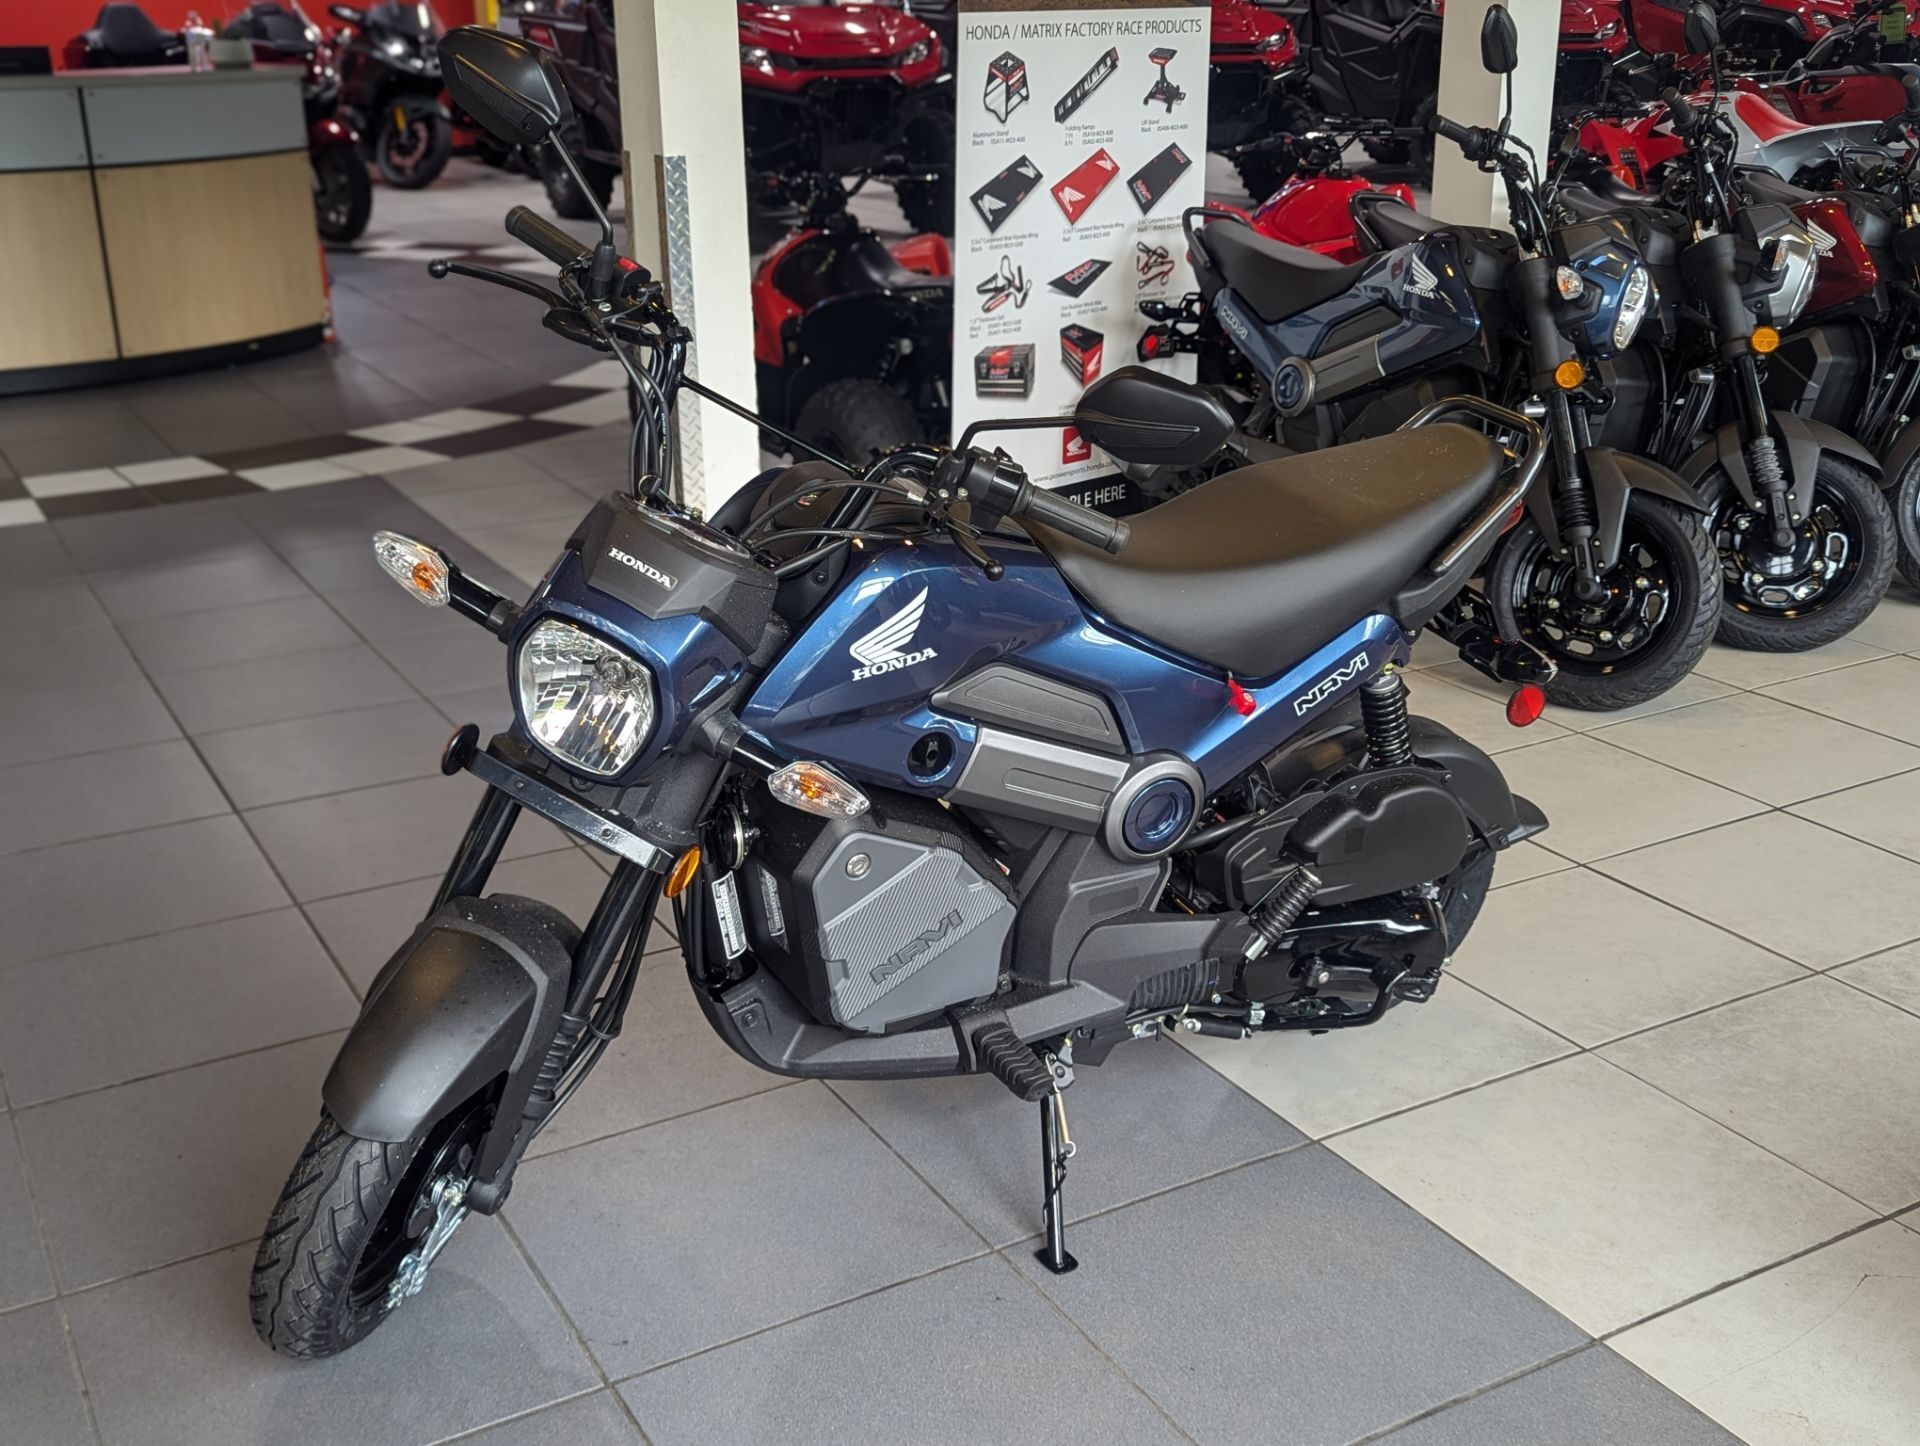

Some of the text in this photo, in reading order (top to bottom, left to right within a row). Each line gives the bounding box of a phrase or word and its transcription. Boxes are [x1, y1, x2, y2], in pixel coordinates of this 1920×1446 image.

[966, 19, 1202, 40] HONDA / MATRIX FACTORY RACE PRODUCTS
[1403, 283, 1435, 299] HONDA
[1095, 484, 1127, 506] HERE
[608, 547, 672, 589] HONDA
[851, 647, 938, 681] HONDA
